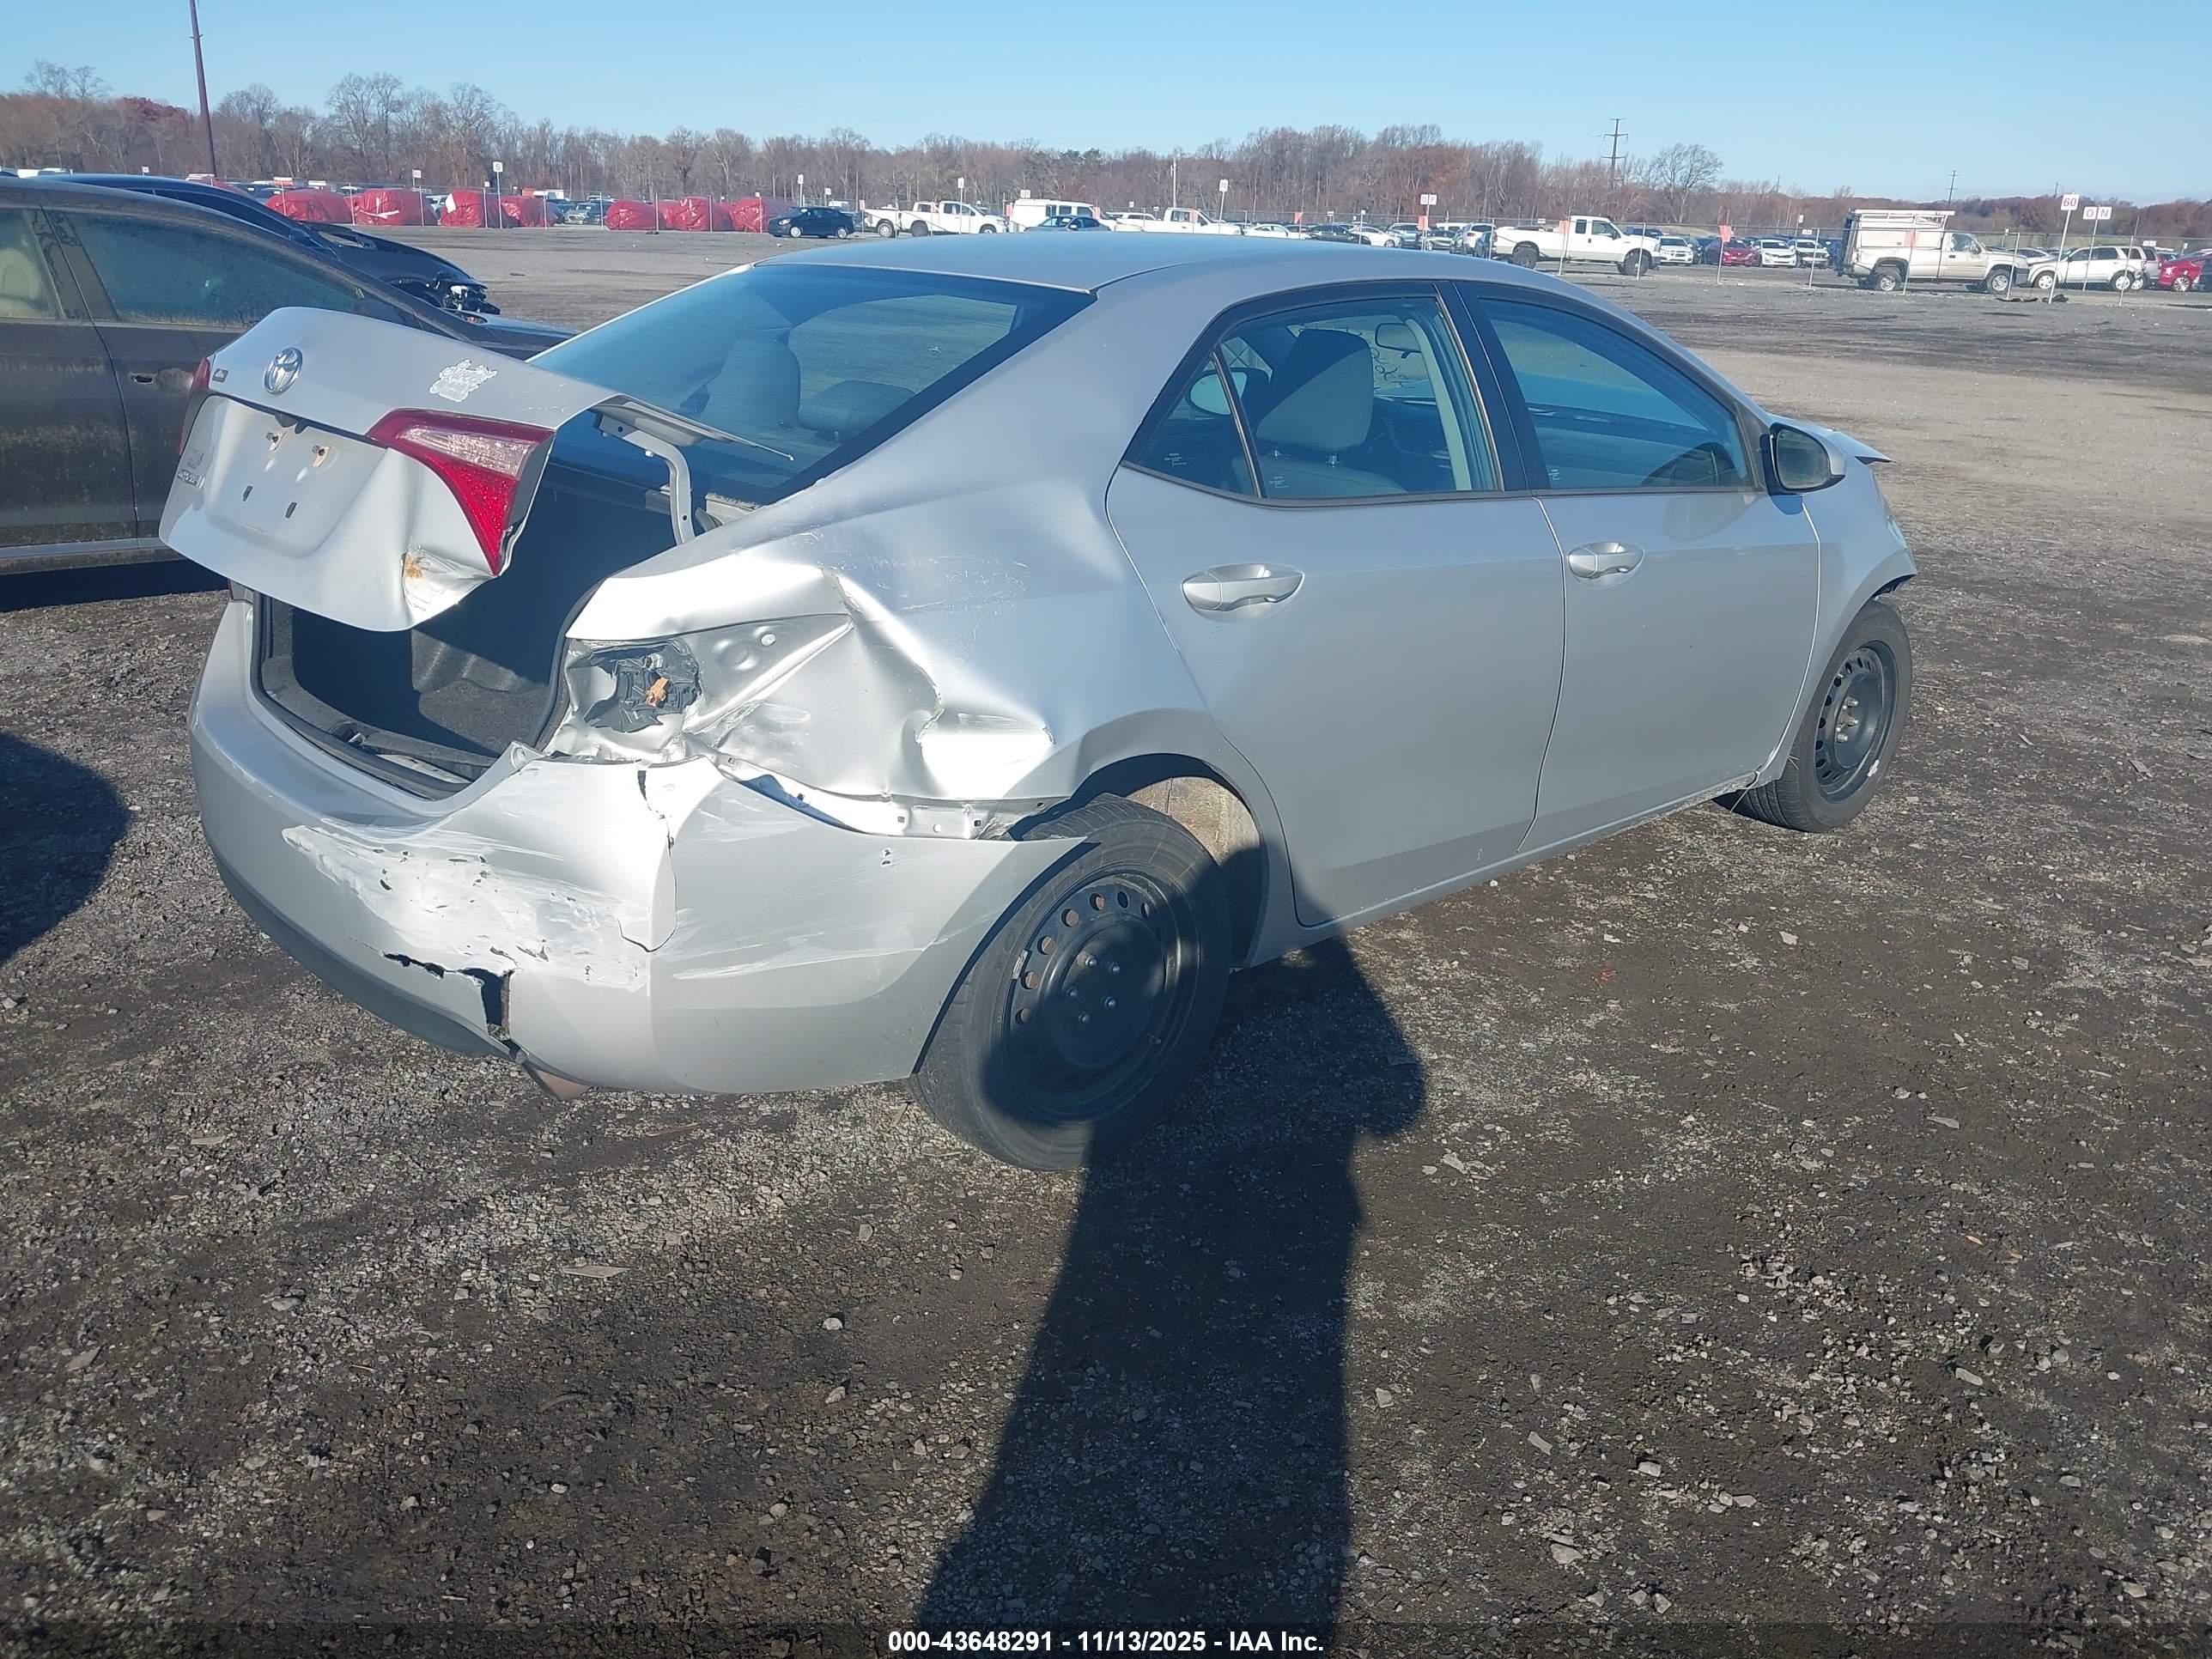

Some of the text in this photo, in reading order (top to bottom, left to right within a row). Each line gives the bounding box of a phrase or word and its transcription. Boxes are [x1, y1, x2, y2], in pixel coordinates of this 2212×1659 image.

[2063, 198, 2077, 207] 60
[2087, 209, 2109, 217] O N
